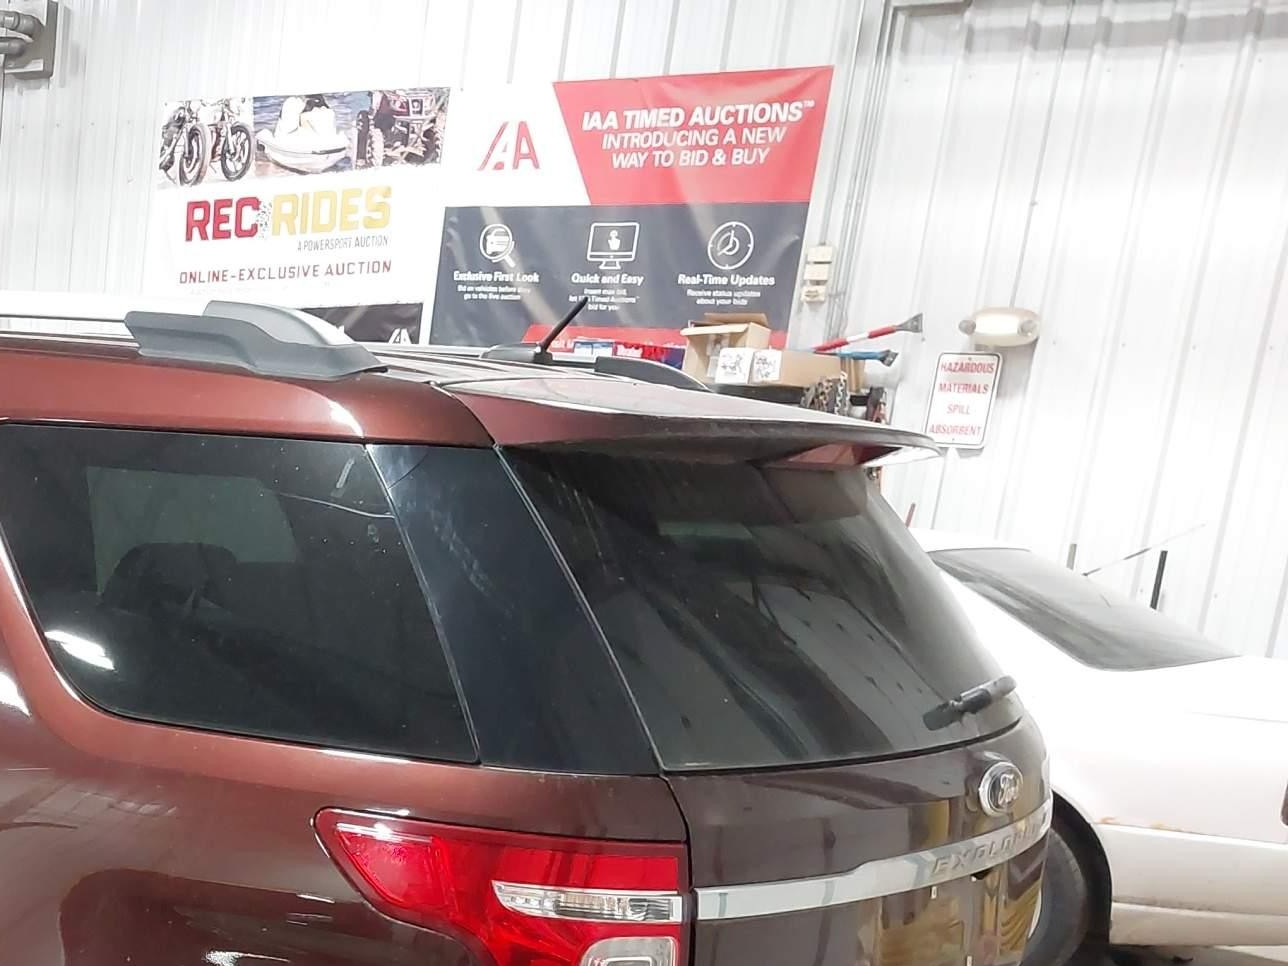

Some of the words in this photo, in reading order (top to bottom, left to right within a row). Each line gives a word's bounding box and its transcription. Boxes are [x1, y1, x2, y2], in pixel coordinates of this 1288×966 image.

[582, 111, 619, 131] IAA
[624, 108, 686, 128] TIMED
[602, 129, 718, 149] INTRODUCING
[723, 128, 736, 145] A
[741, 126, 787, 144] NEW
[612, 152, 649, 169] WAY
[652, 150, 675, 167] TO
[679, 149, 708, 166] BID
[712, 149, 726, 165] &
[731, 147, 770, 164] BUY
[185, 196, 261, 242] REC
[271, 186, 392, 236] RIDES
[354, 235, 389, 248] AUCTION
[179, 264, 319, 284] ONLINE-EXCLUSIVE
[324, 259, 392, 276] AUCTION
[453, 270, 493, 281] Exclusive
[494, 271, 514, 282] First
[516, 272, 540, 283] Look
[572, 272, 600, 283] Quick
[601, 274, 620, 284] and
[621, 273, 644, 286] Easy
[678, 273, 728, 285] Real-Time
[730, 274, 776, 287] Updates
[941, 361, 996, 374] HAZARDOUS
[938, 383, 990, 394] MATERIALS
[946, 403, 970, 415] SPILL
[929, 424, 982, 437] ABSORBENT
